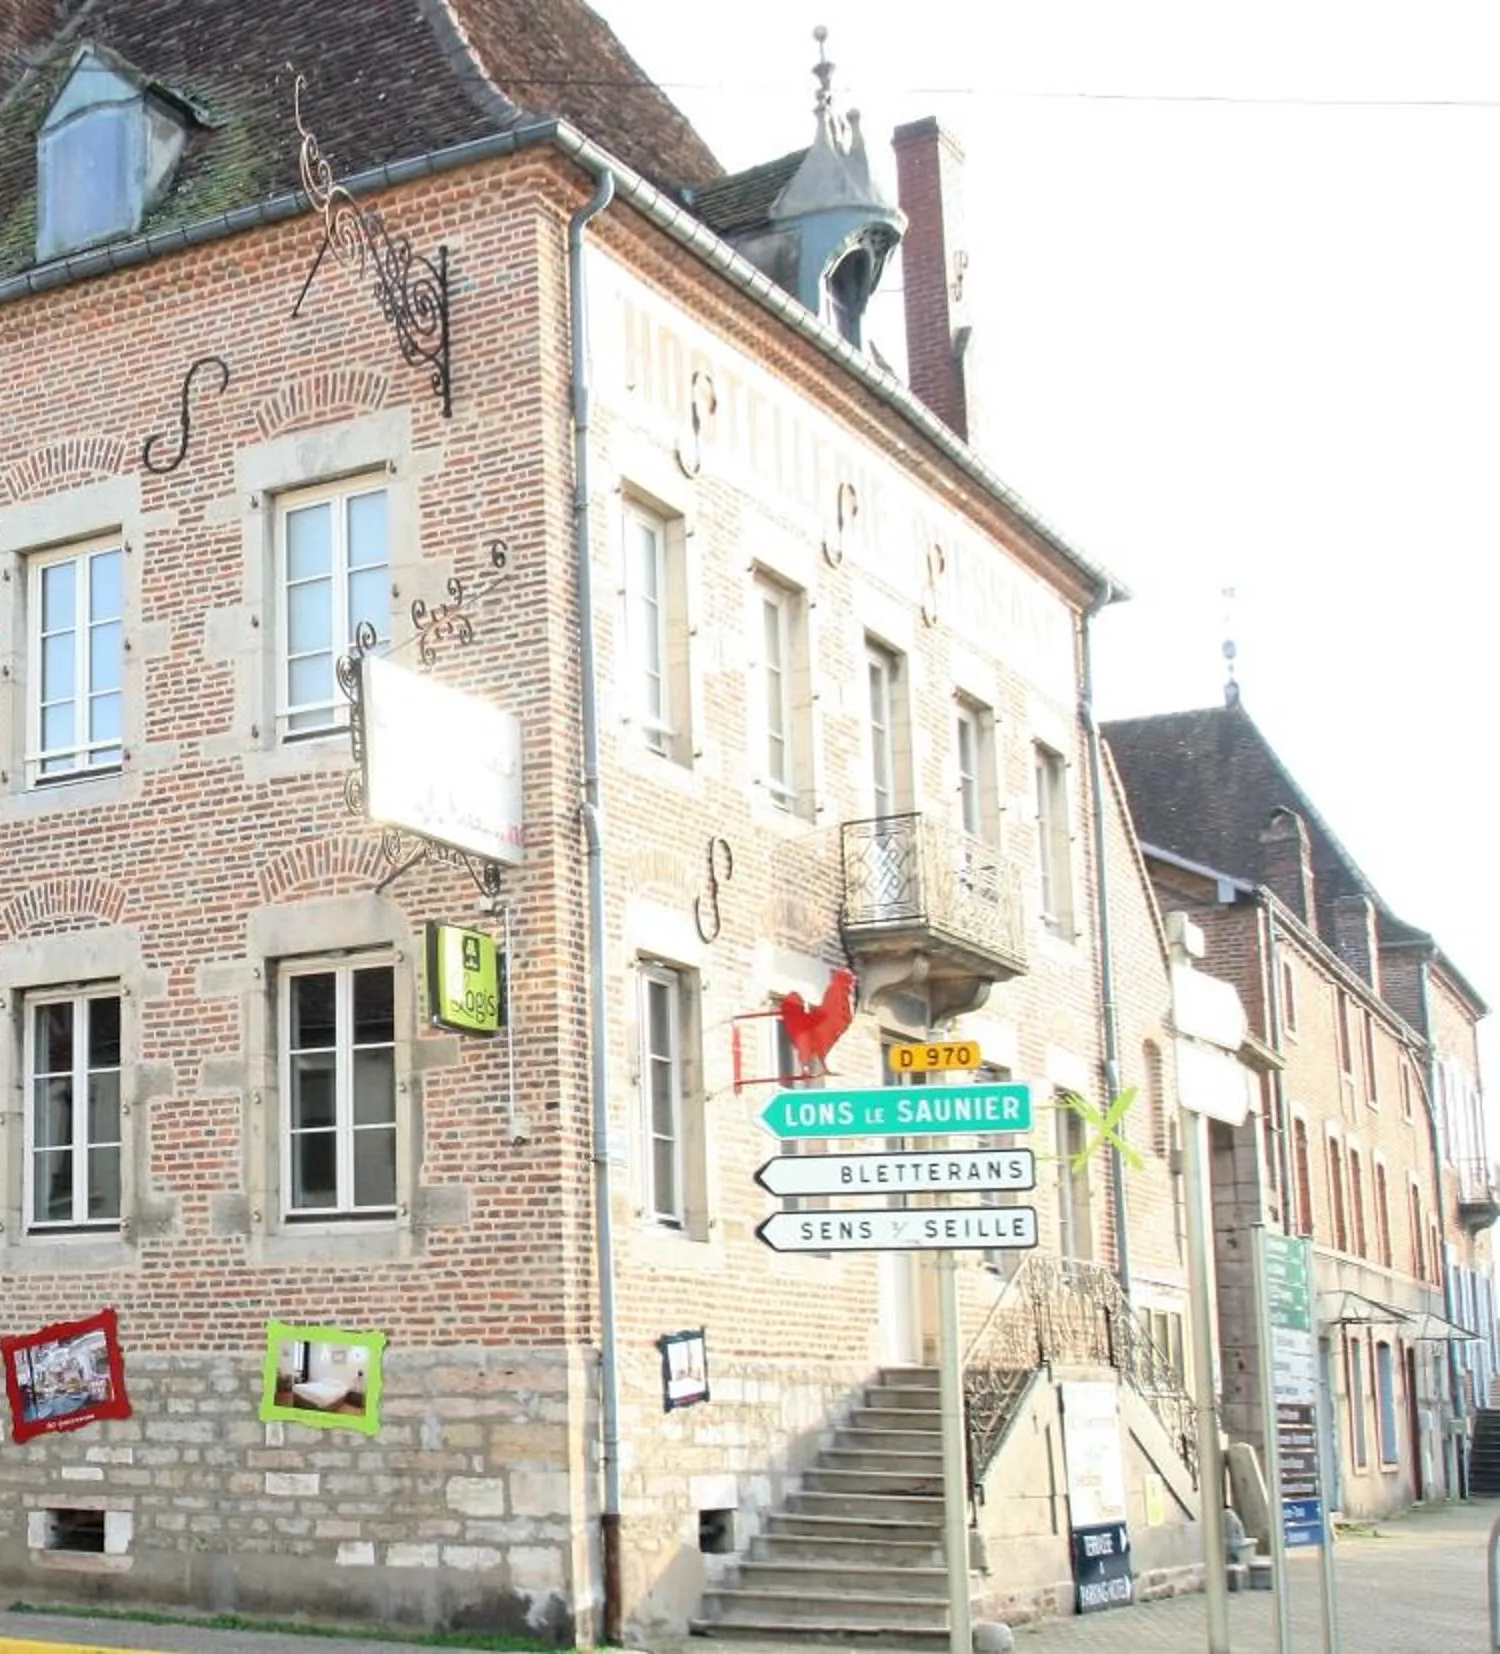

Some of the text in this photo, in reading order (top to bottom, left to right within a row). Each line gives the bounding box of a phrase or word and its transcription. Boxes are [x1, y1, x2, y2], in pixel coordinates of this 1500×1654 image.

[900, 1047, 971, 1067] D 970
[784, 1096, 1020, 1127] LONS LE SAUNIER
[840, 1160, 1023, 1184] BLETTERANS
[800, 1221, 873, 1240] SENS
[924, 1217, 1026, 1238] SEILLE
